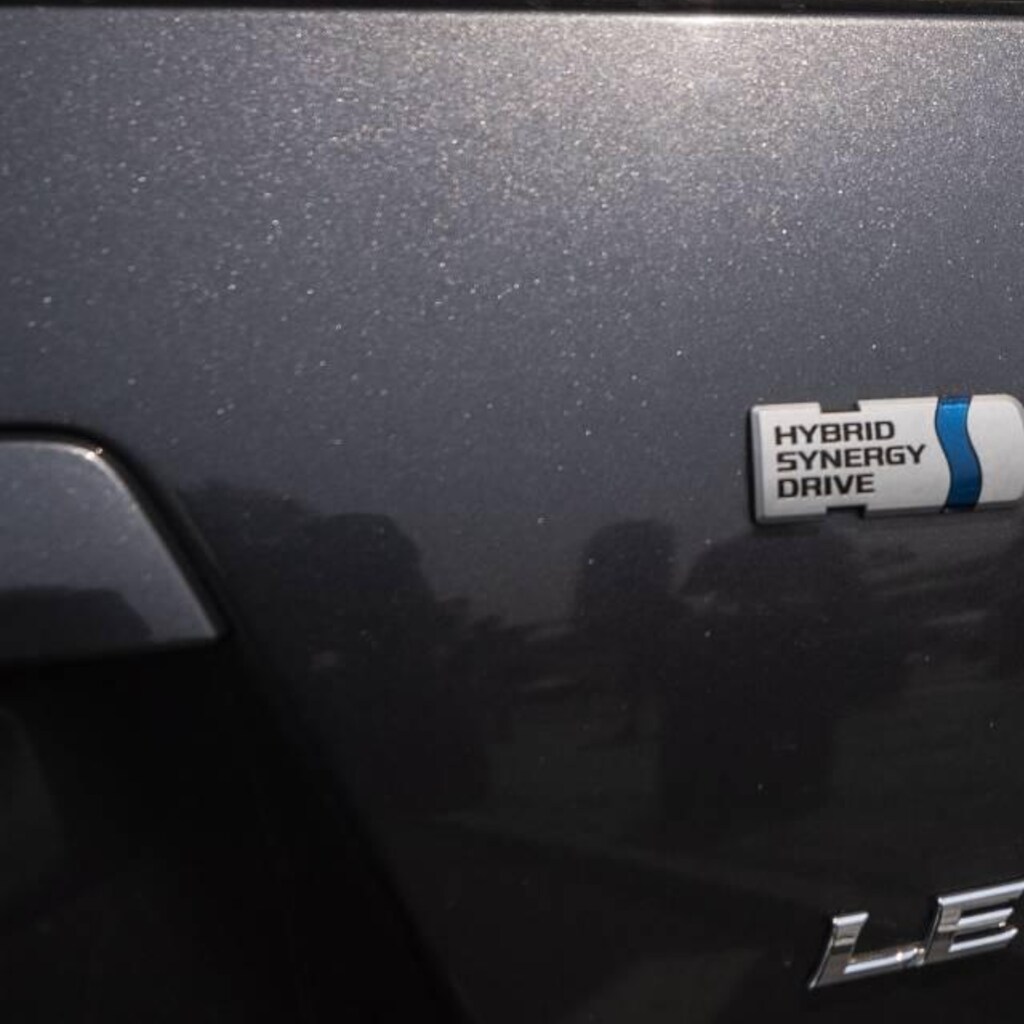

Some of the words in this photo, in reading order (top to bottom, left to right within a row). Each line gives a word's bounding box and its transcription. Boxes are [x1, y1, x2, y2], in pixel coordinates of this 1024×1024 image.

[775, 421, 895, 445] HYBRID
[777, 444, 926, 472] SYNERGY
[777, 473, 875, 499] DRIVE
